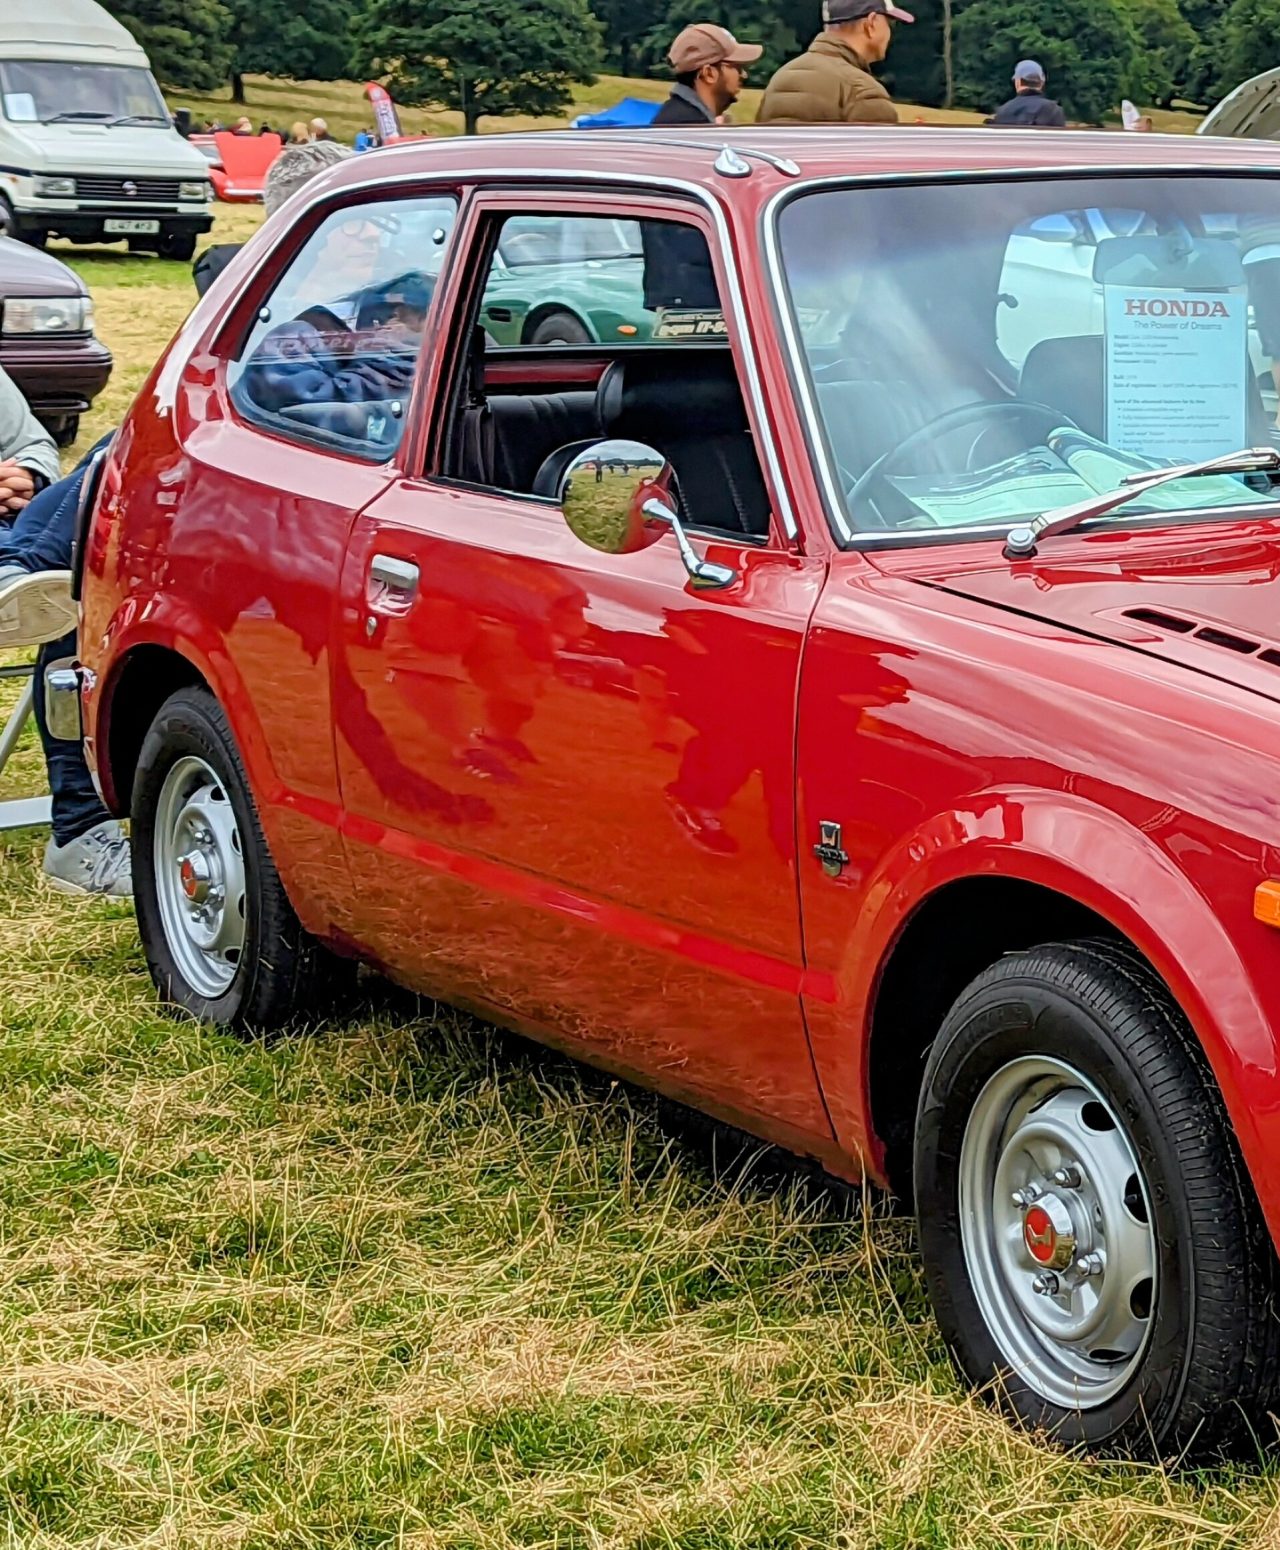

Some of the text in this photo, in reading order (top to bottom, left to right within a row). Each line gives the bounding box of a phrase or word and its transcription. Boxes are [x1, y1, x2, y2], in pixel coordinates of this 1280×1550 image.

[1124, 298, 1231, 318] HONDA
[1134, 320, 1149, 329] The
[1150, 320, 1178, 330] Power
[1180, 321, 1190, 330] of
